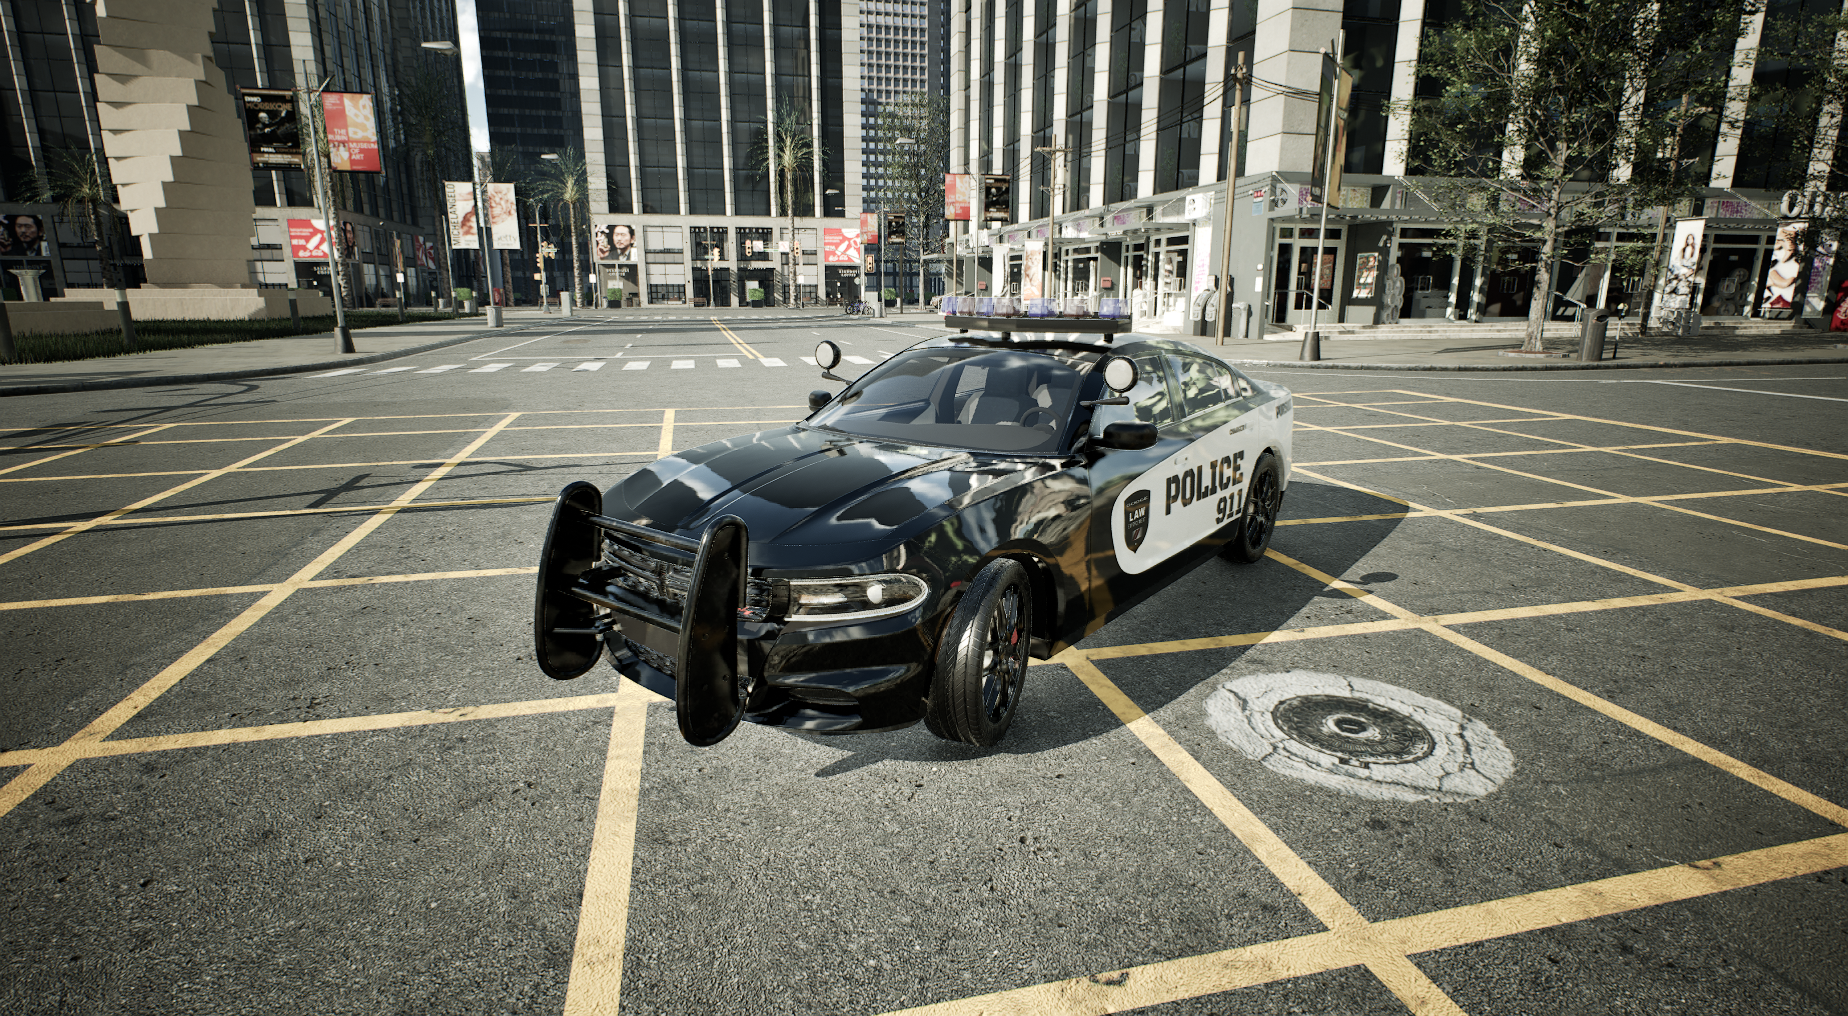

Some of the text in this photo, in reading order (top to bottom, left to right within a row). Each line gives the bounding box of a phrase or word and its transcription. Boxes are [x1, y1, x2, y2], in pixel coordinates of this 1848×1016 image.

[446, 183, 461, 247] MICHELANGELO
[1165, 450, 1244, 516] POLICE
[1215, 488, 1243, 525] 911
[1129, 506, 1146, 522] LAW
